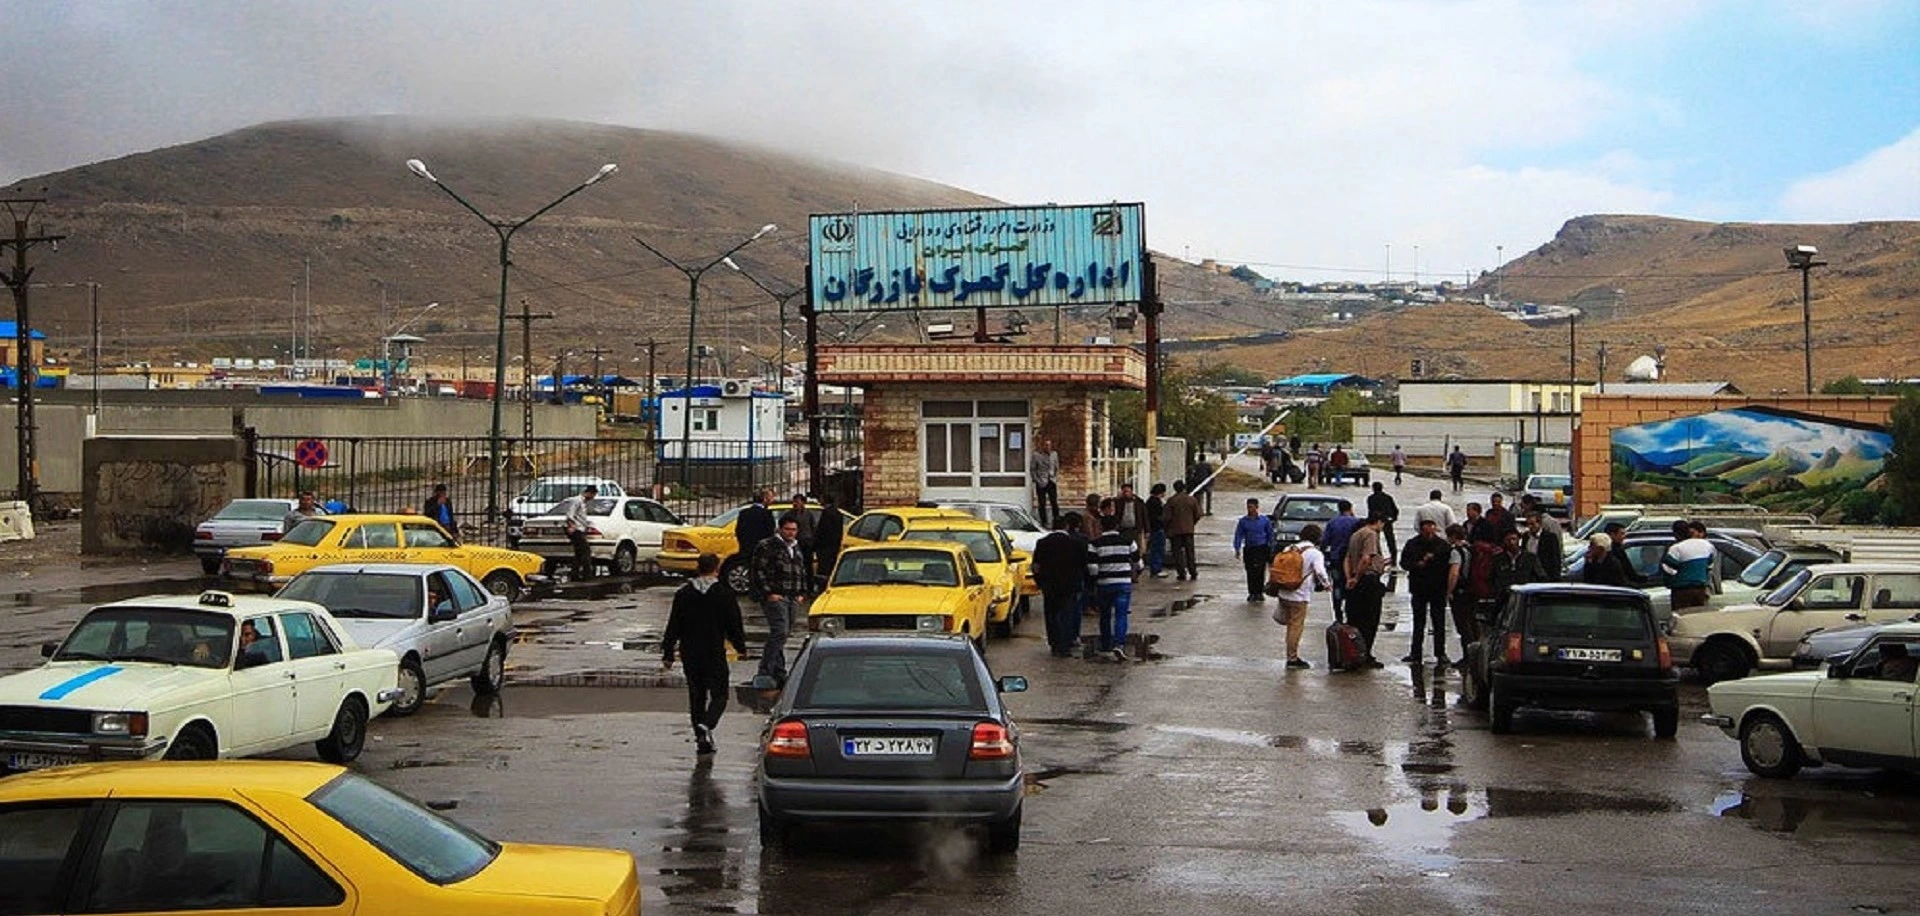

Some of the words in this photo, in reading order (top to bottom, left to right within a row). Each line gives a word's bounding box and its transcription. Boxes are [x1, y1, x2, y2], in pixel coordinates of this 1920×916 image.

[896, 221, 933, 243] دارایی
[944, 215, 987, 239] اقتصادی
[990, 221, 1012, 234] امور
[1013, 218, 1055, 234] وزارت
[922, 243, 973, 259] ایران
[974, 239, 1029, 256] گمرک
[823, 265, 923, 303] بازرگان
[929, 261, 1010, 302] گمرک
[1012, 261, 1052, 299] کل
[1055, 261, 1130, 298] اداره
